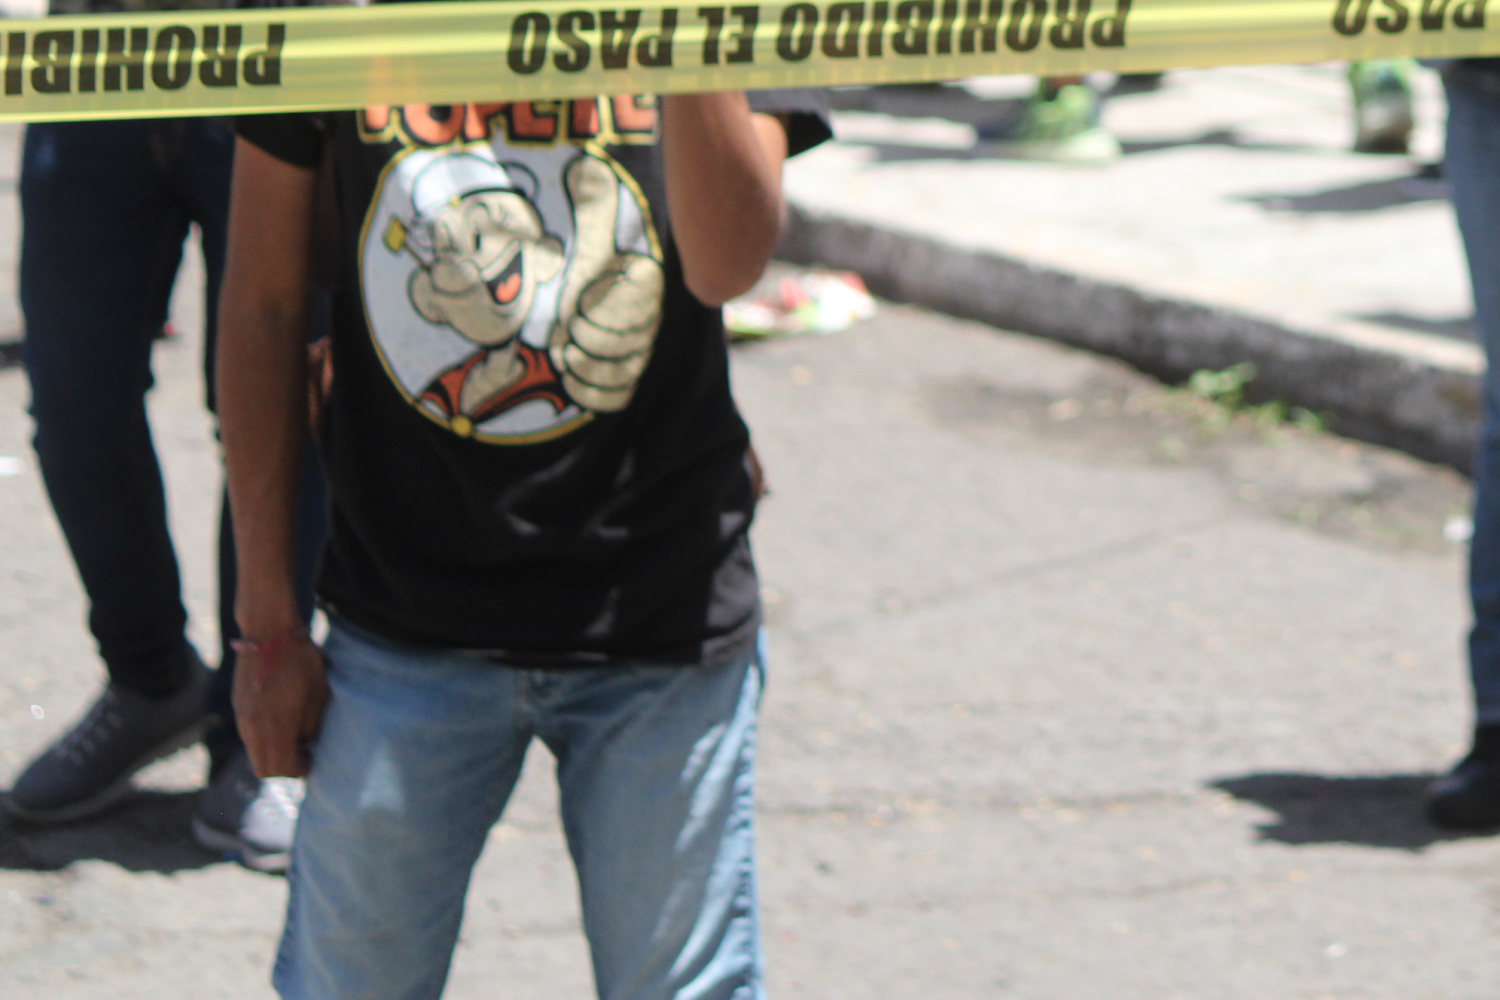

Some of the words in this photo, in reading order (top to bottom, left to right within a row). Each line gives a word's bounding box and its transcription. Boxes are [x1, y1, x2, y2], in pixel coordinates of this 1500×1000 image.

[5, 23, 286, 96] PROHIBI
[506, 7, 679, 75] PASO
[698, 4, 760, 66] EL
